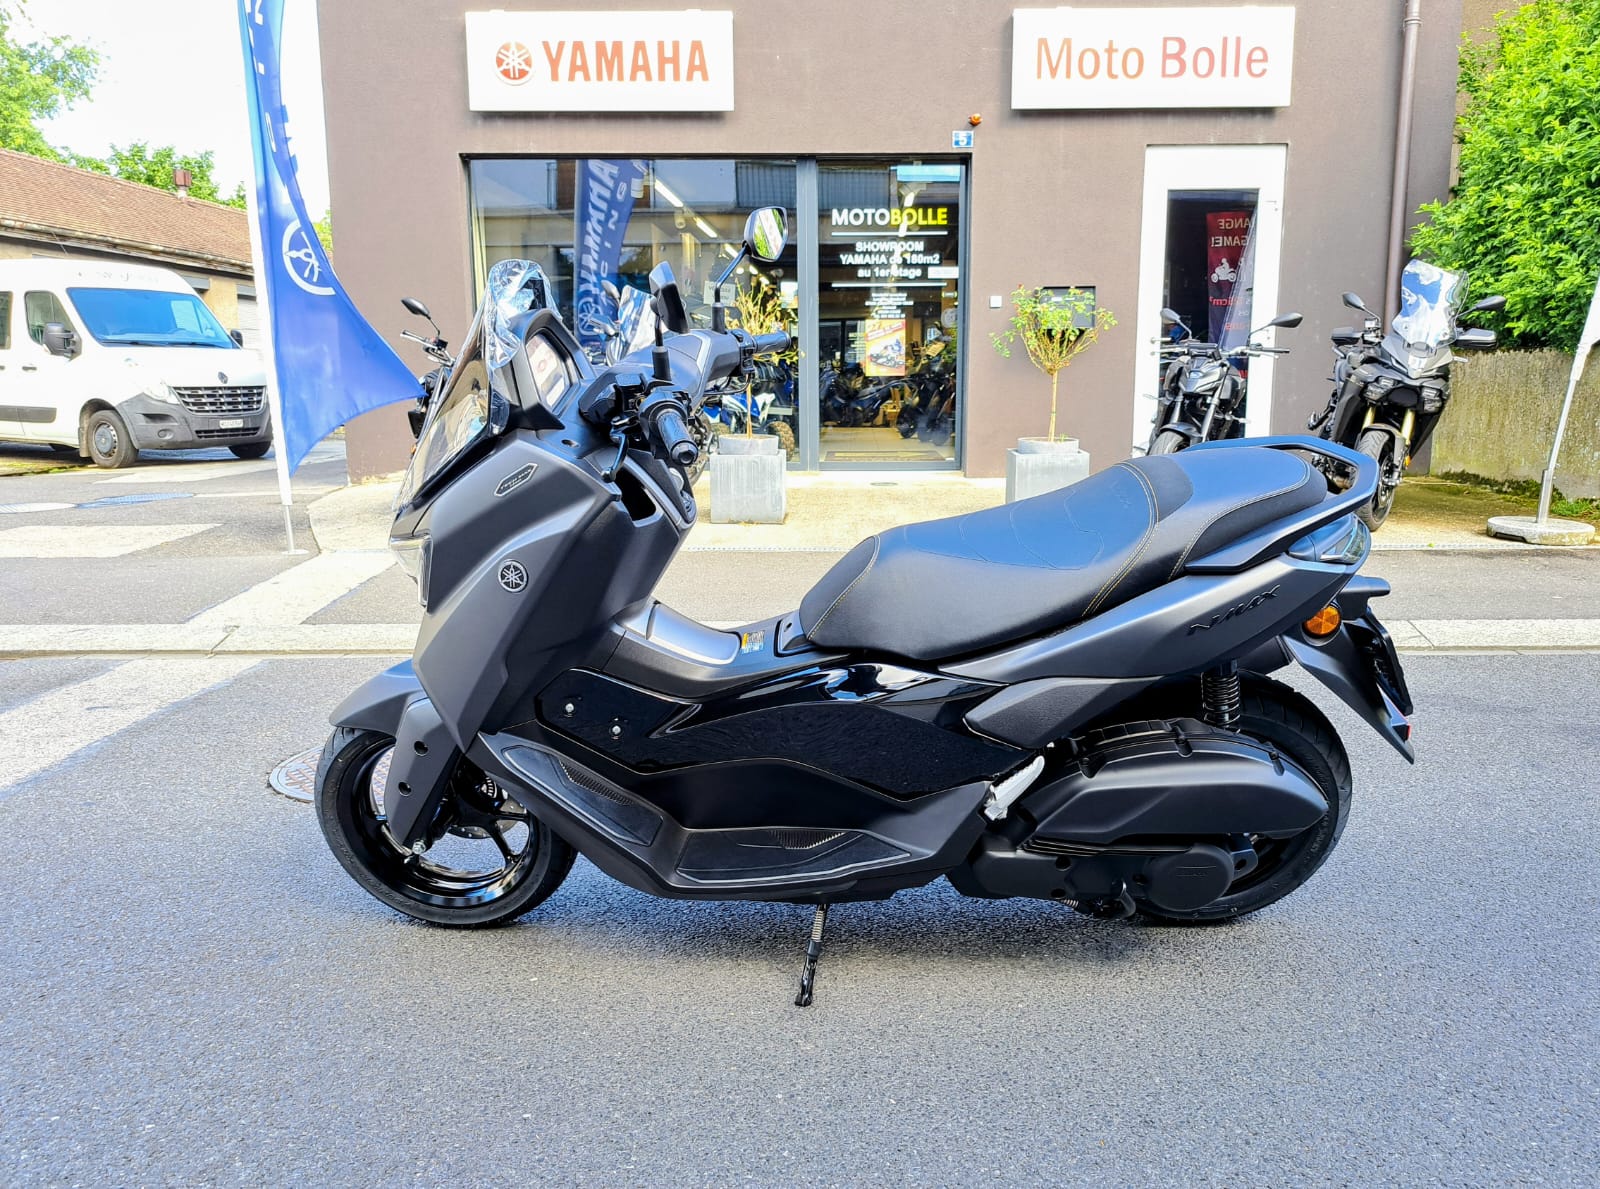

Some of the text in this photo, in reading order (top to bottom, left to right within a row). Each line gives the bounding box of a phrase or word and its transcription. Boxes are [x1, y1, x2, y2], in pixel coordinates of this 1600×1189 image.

[541, 40, 710, 82] YAMAHA
[1036, 36, 1269, 80] Moto Bolle
[958, 132, 968, 146] 5
[831, 208, 948, 226] MOTOBOLLE
[600, 182, 628, 307] ACING
[855, 241, 924, 252] SHOWROOM
[840, 254, 887, 265] YAMAHA
[857, 269, 871, 278] au
